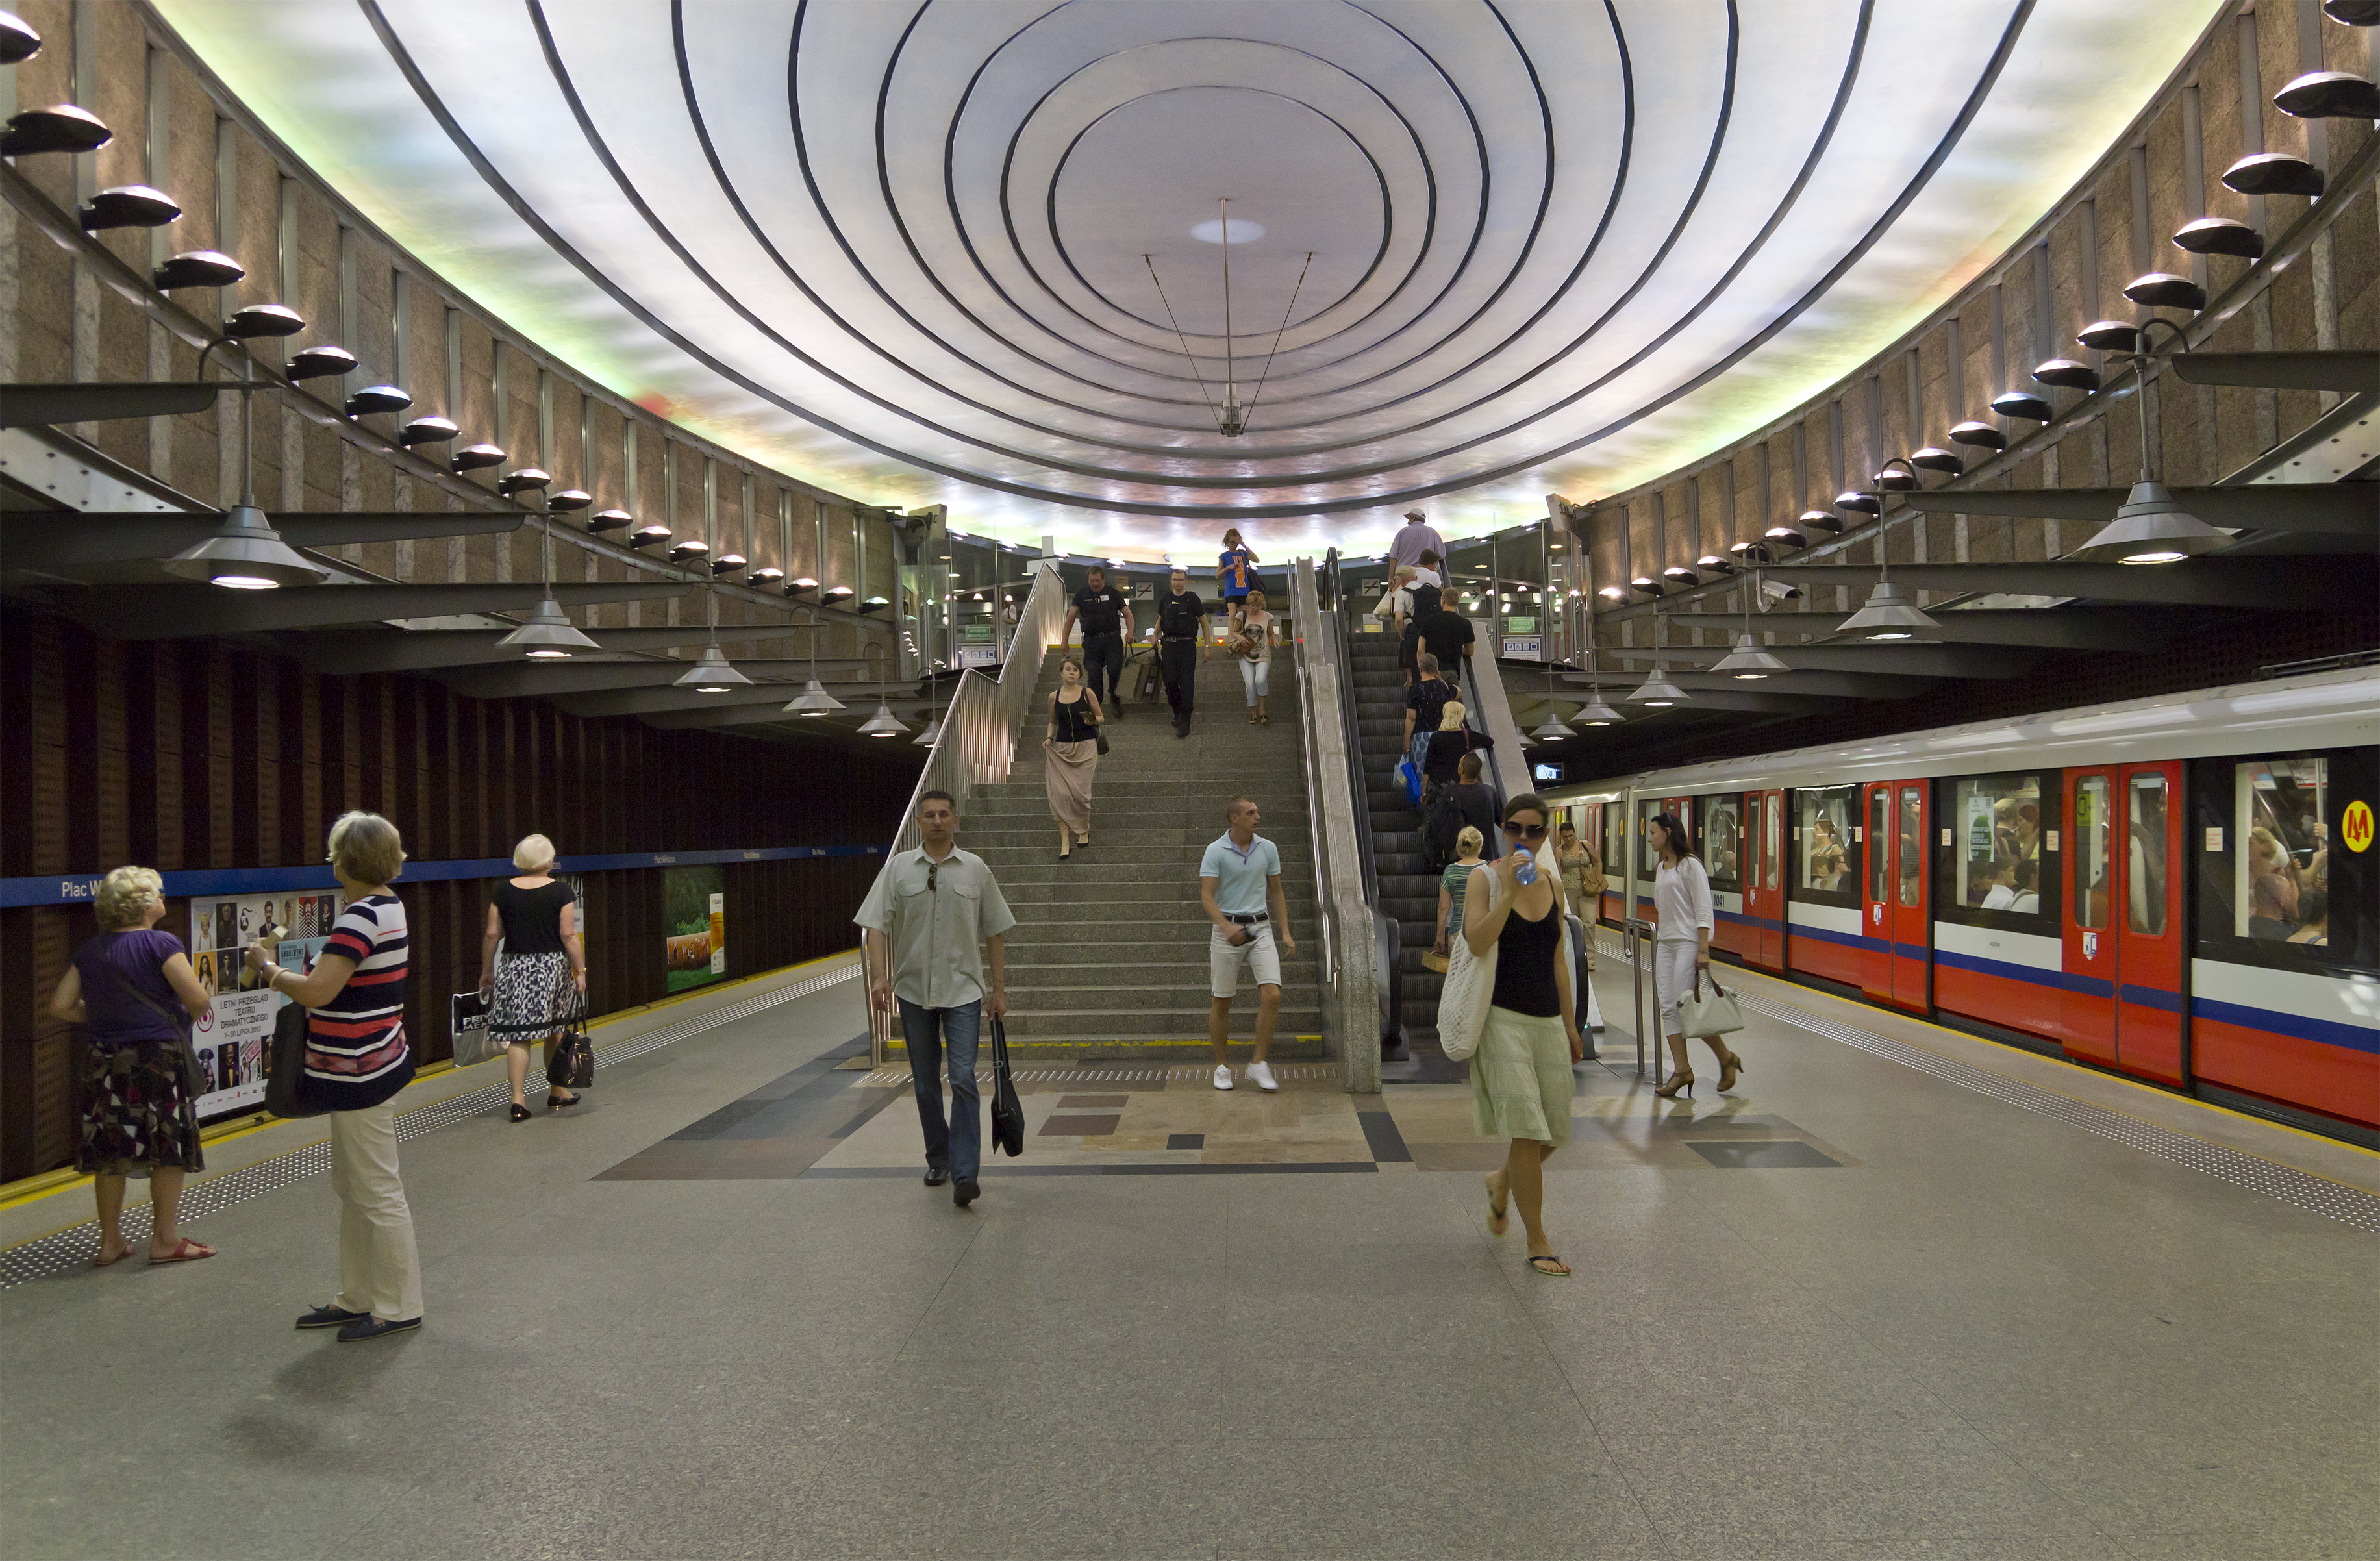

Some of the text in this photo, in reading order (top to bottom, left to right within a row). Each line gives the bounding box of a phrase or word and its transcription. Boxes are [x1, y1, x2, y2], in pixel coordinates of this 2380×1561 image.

[1232, 555, 1246, 588] USA
[2347, 809, 2369, 843] M
[62, 881, 87, 898] Plac
[1714, 893, 1724, 908] 1041
[220, 994, 268, 1009] LETNI PRZEGLĄD
[234, 1006, 255, 1016] TEATRU
[221, 1013, 268, 1029] DRAMATYCZNEGO
[236, 1028, 250, 1036] LIPCA
